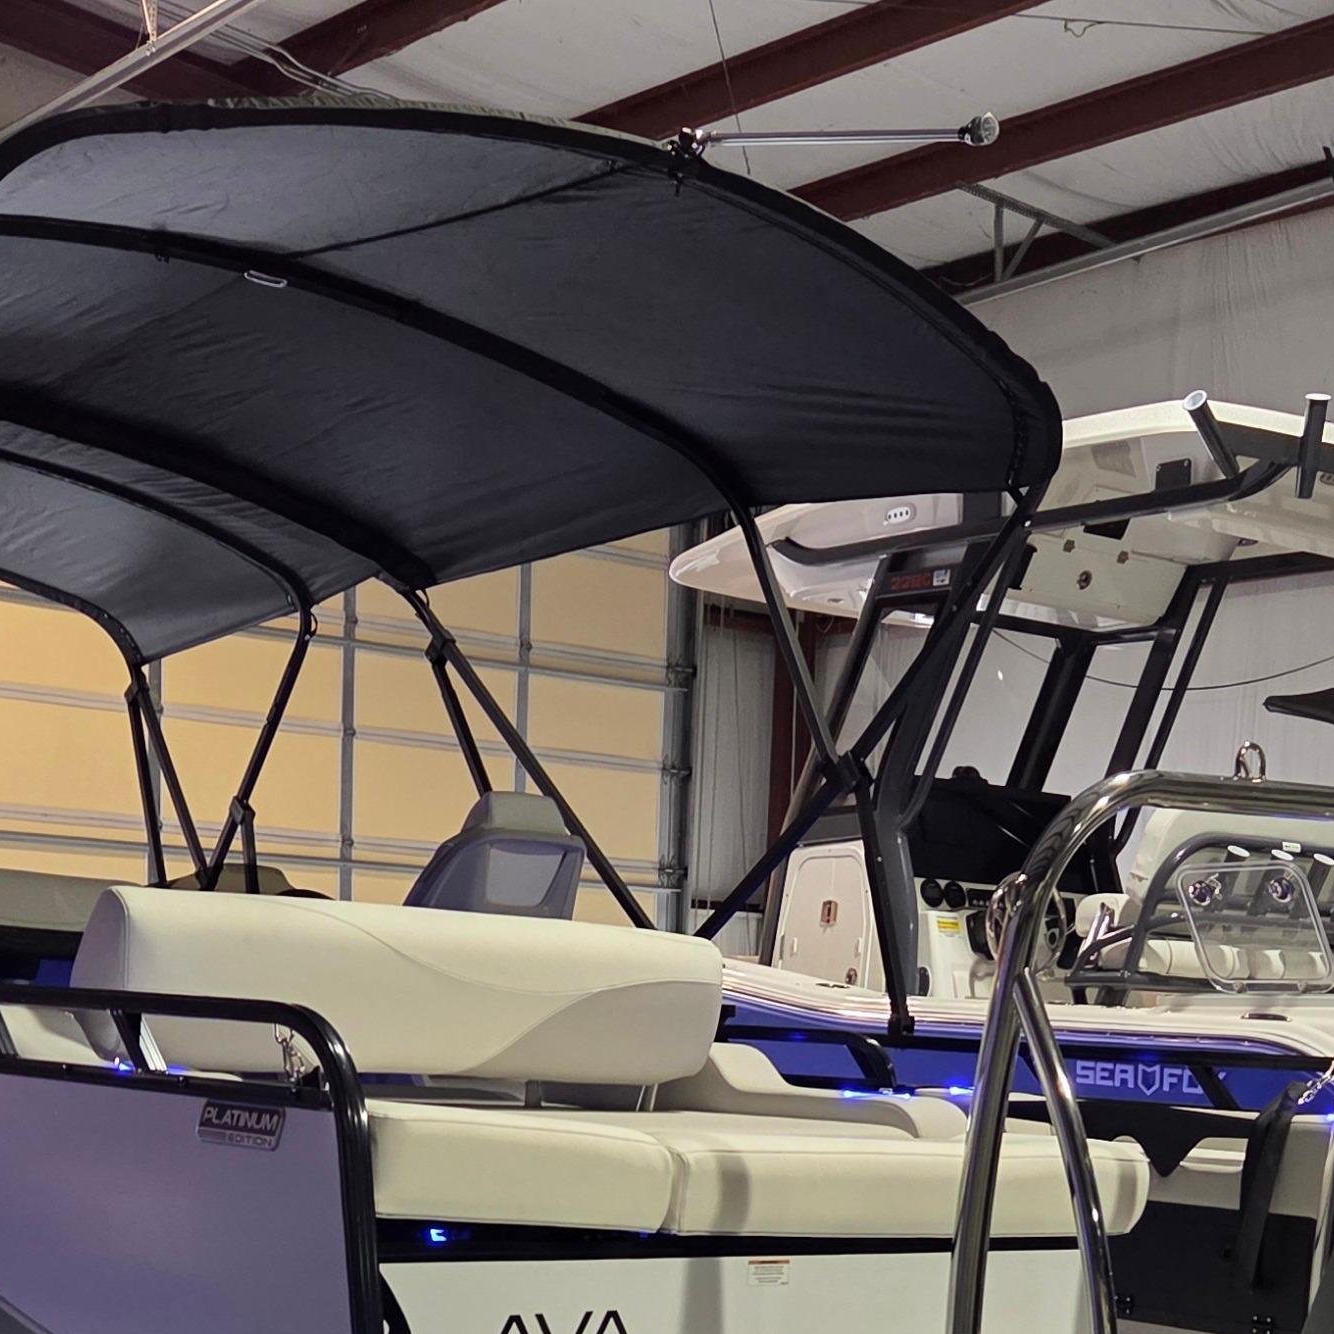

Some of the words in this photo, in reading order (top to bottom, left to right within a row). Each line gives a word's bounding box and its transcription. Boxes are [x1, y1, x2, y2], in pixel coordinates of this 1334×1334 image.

[1076, 1060, 1135, 1089] SEA
[203, 1106, 279, 1131] PLATINUM
[226, 1132, 274, 1148] EDITION
